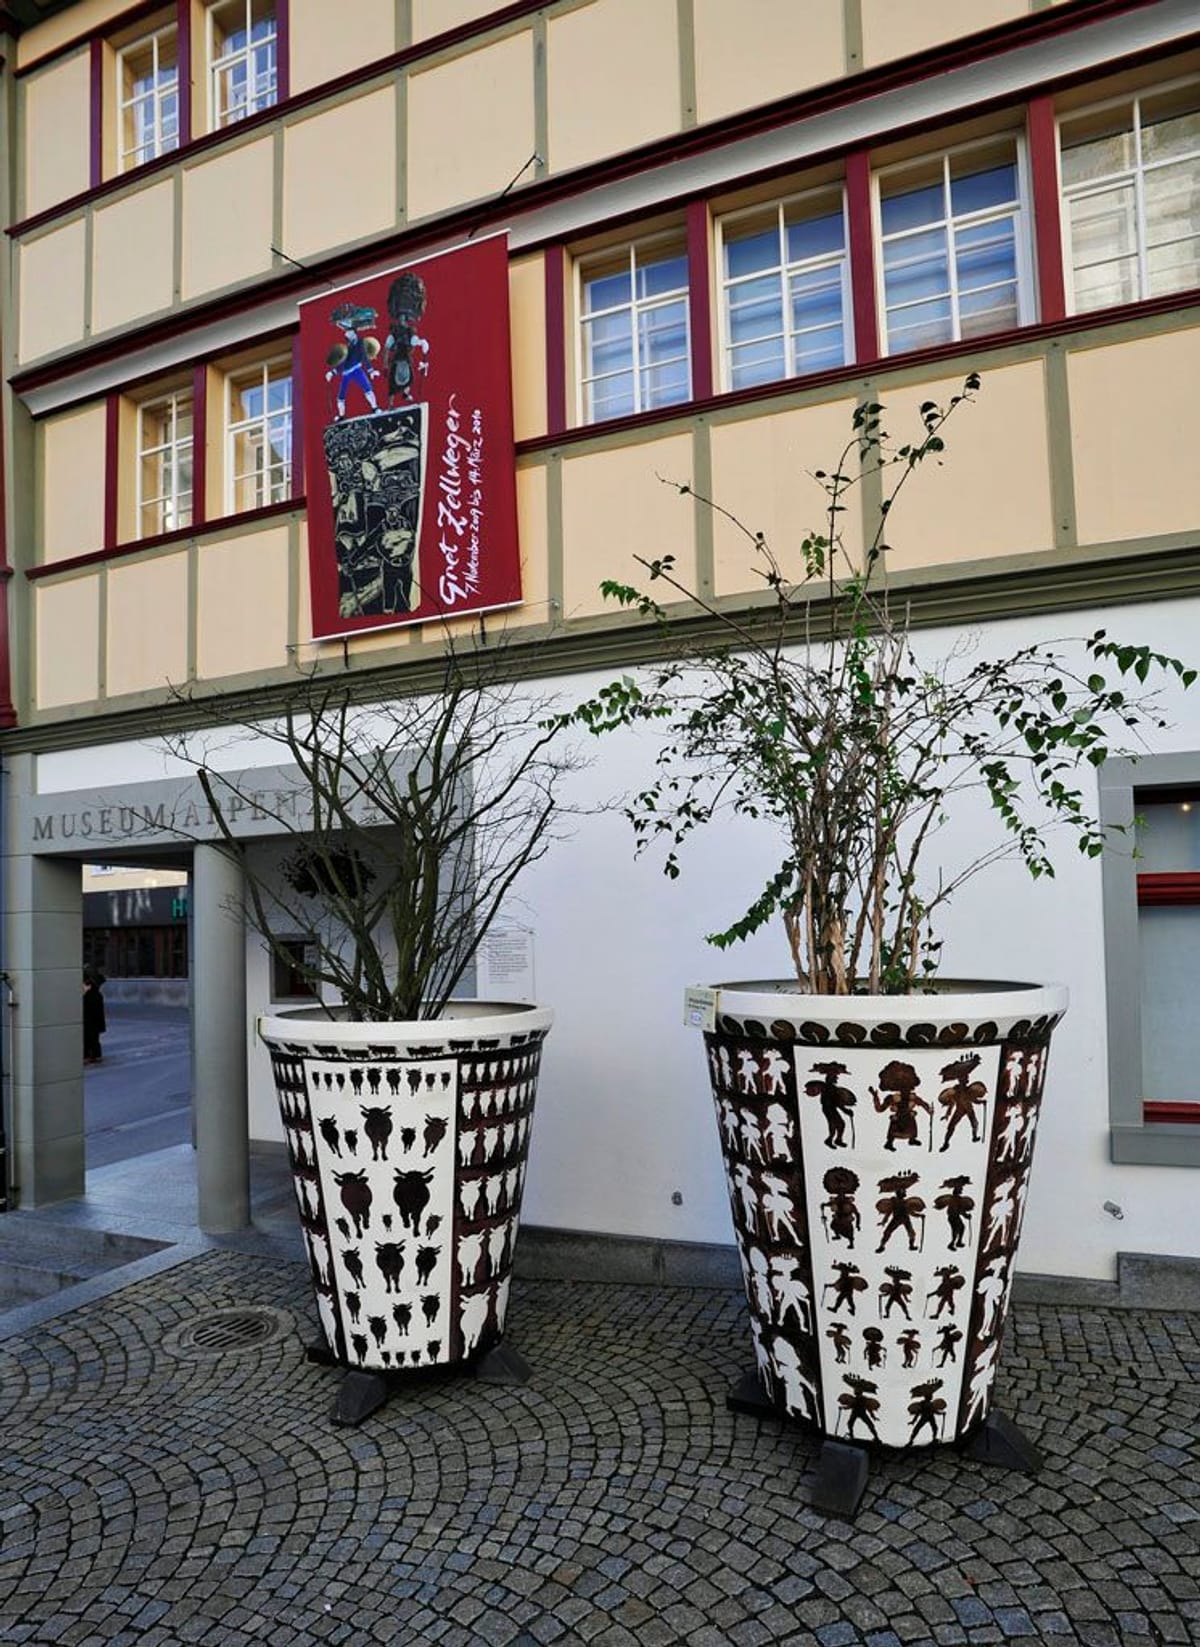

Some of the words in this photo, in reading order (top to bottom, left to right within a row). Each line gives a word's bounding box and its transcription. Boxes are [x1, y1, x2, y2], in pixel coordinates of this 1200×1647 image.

[437, 393, 472, 536] Zellweger
[467, 488, 482, 507] bis
[469, 508, 484, 532] 2009
[439, 532, 468, 605] Gret
[33, 803, 165, 841] MUSEUM
